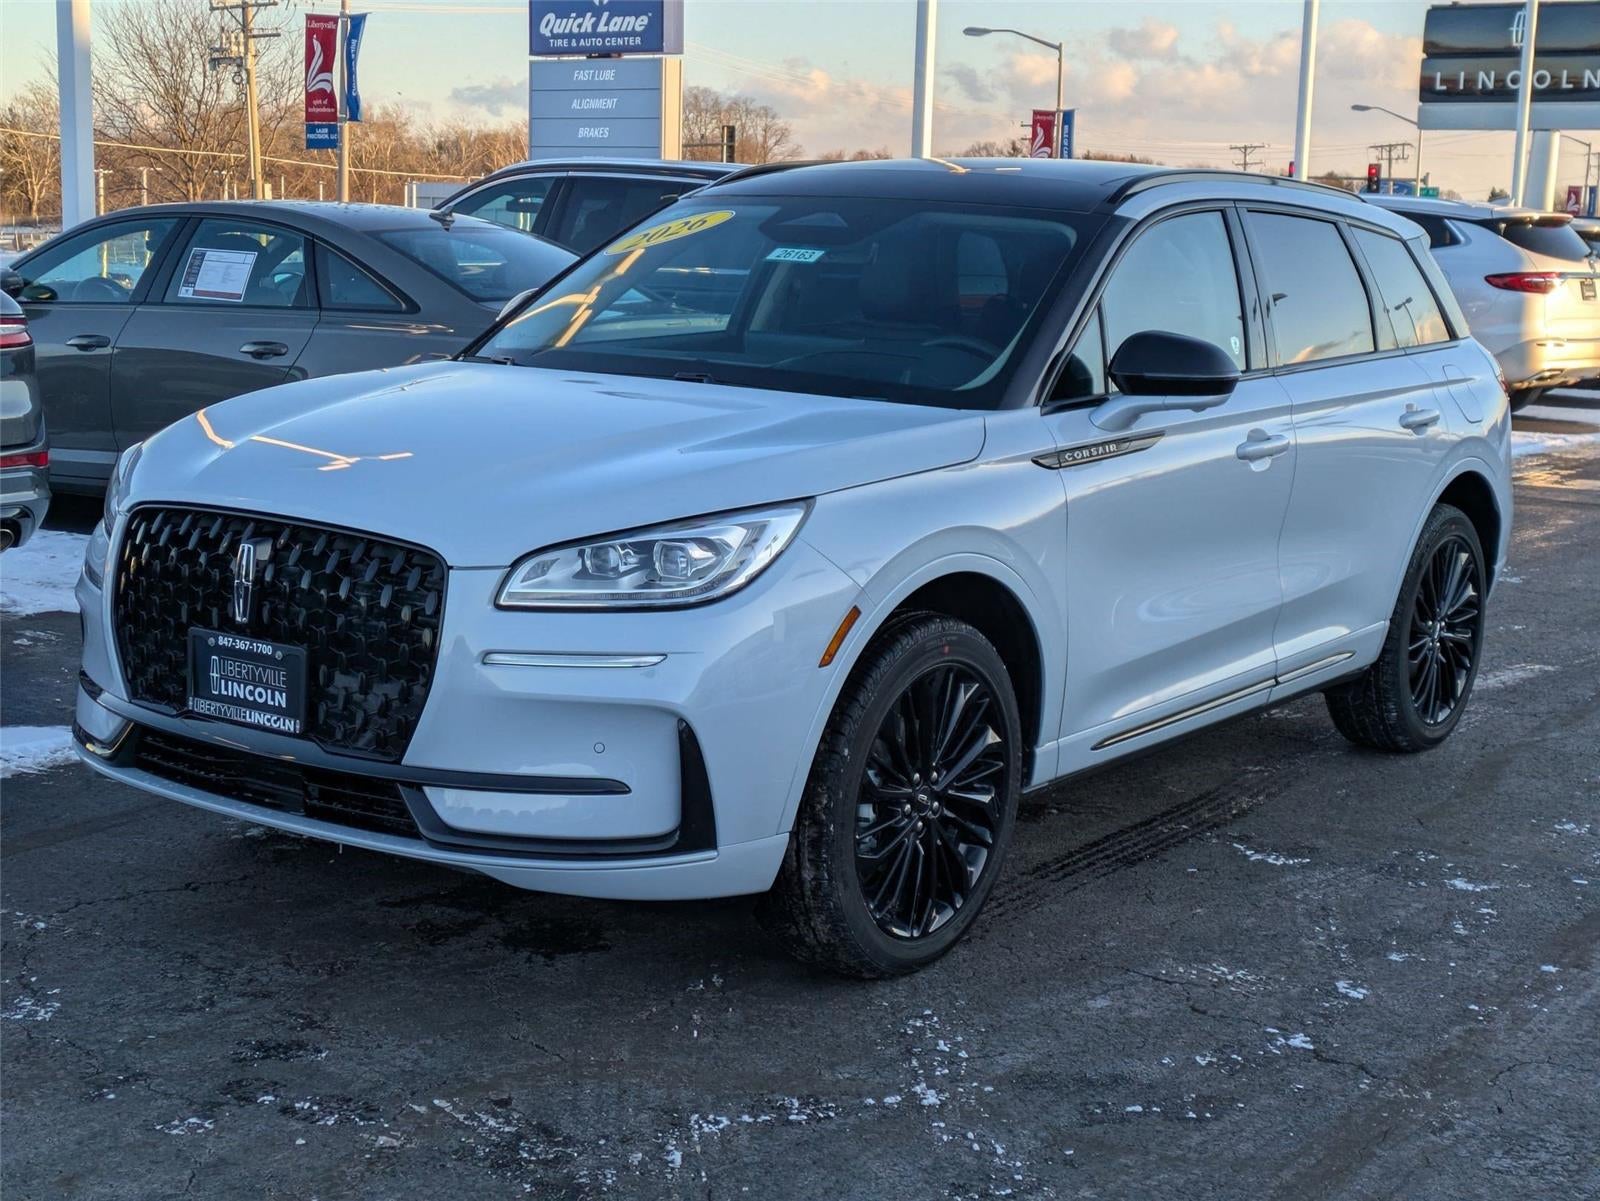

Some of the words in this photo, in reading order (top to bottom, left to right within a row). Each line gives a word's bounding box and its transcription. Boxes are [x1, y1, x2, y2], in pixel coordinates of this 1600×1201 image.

[539, 12, 595, 36] Quick
[597, 11, 649, 33] Lane
[549, 38, 568, 47] TIRE
[571, 38, 576, 47] &
[580, 38, 602, 47] AUTO
[605, 37, 641, 46] CENTER
[573, 70, 595, 81] FAST
[595, 69, 616, 81] LUBE
[1435, 69, 1600, 90] LINCOLN
[571, 98, 618, 110] ALIGNMENT
[578, 127, 609, 138] BRAKES
[623, 219, 708, 250] 2026
[775, 249, 816, 260] 26163
[1065, 443, 1118, 461] CORSAIR
[218, 635, 273, 655] 847-367-1700
[220, 658, 287, 688] LIBERTYVILLE
[220, 679, 287, 708] LINCOLN
